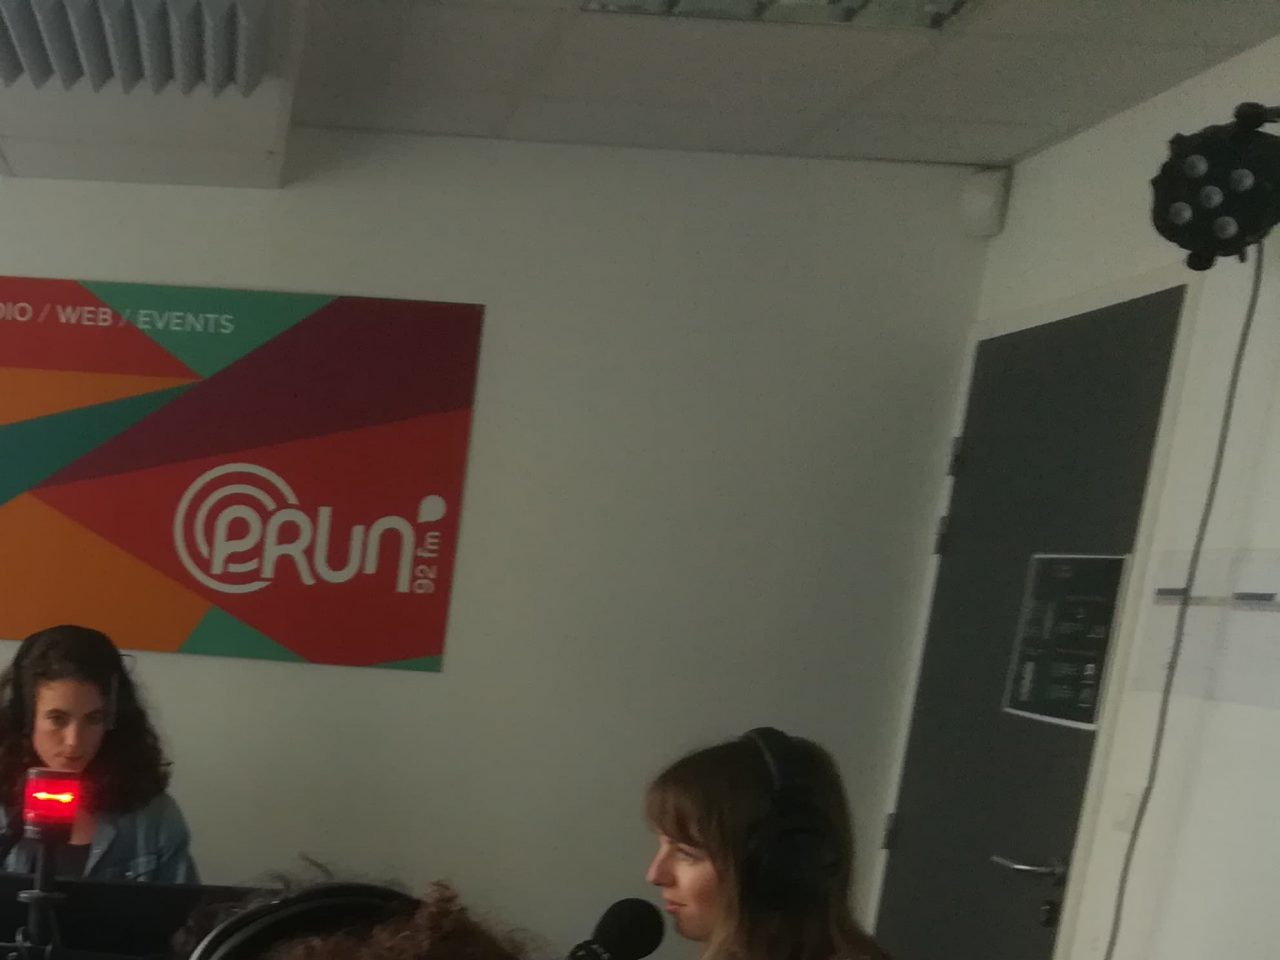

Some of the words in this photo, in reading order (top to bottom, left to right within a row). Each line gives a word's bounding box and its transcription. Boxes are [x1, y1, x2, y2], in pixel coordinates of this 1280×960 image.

[56, 305, 113, 328] WEB
[136, 311, 236, 334] EVENTS
[412, 565, 438, 594] 92
